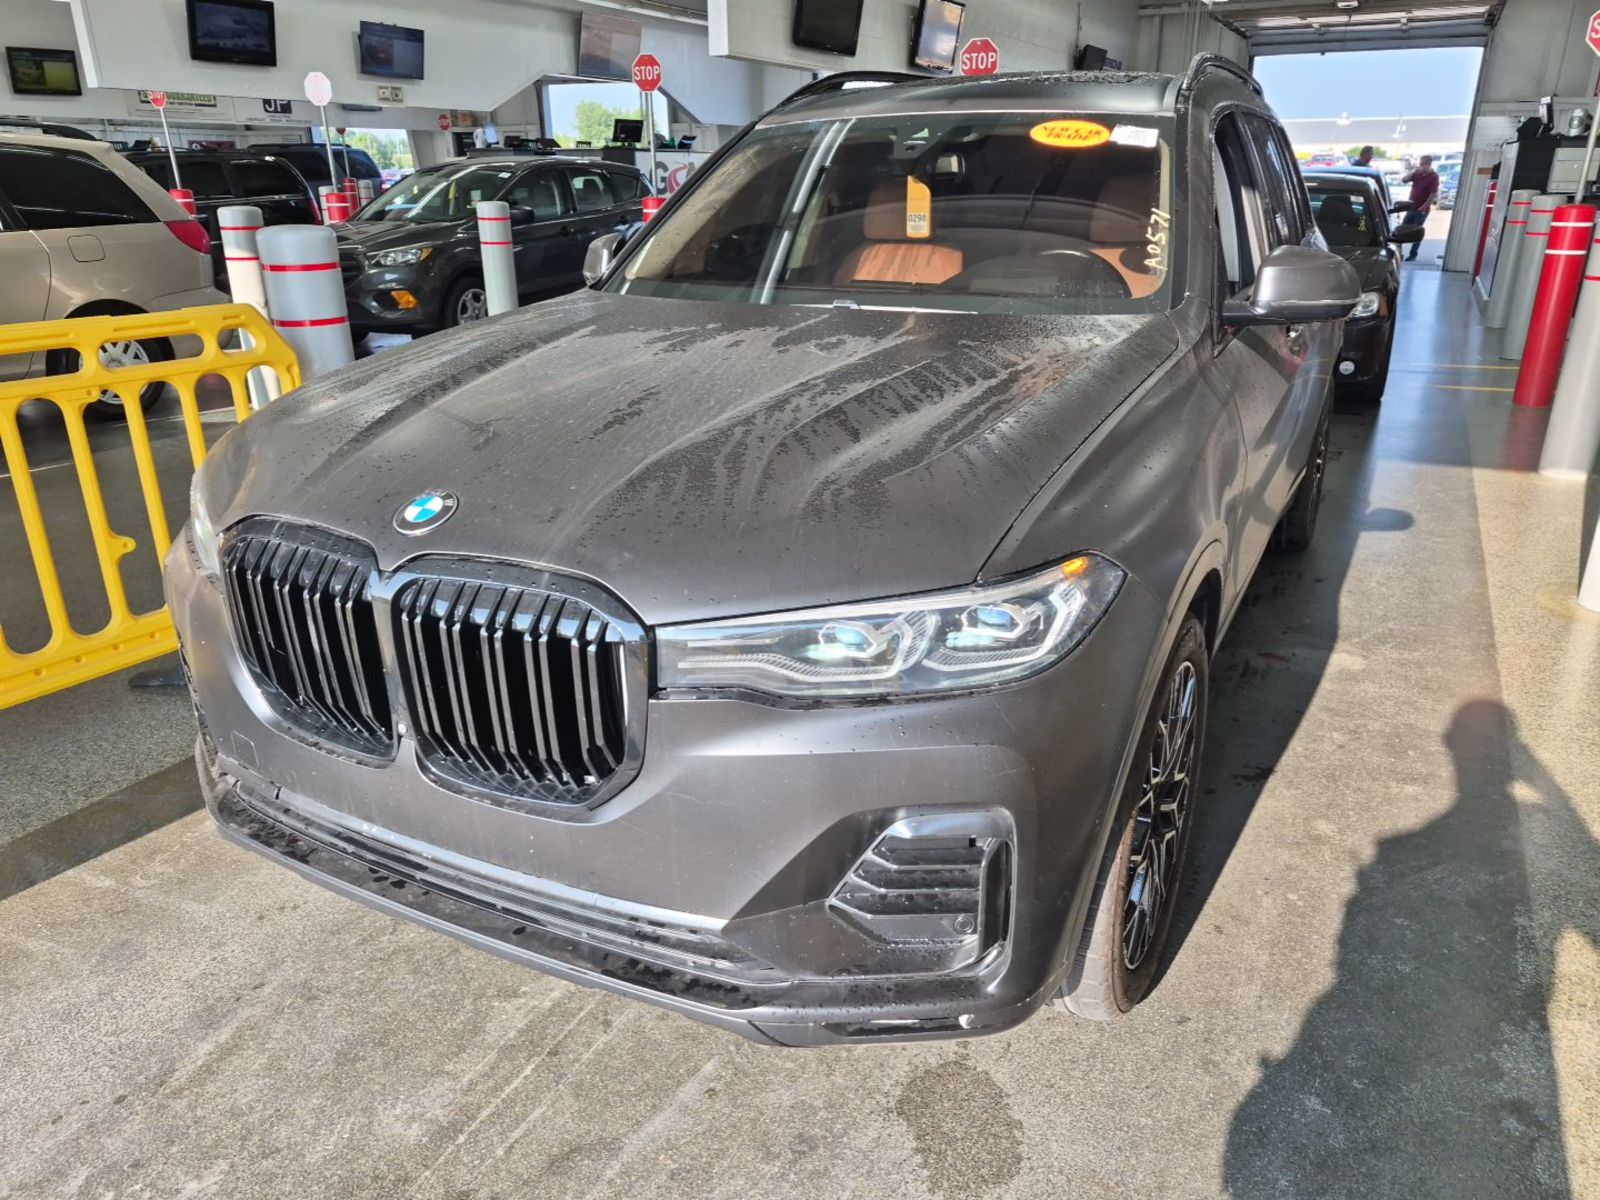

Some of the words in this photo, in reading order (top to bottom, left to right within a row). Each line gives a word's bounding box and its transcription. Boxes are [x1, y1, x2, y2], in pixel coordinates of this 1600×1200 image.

[962, 52, 997, 70] STOP
[633, 65, 661, 81] STOP
[908, 214, 927, 223] 0298
[1143, 208, 1171, 271] A0571
